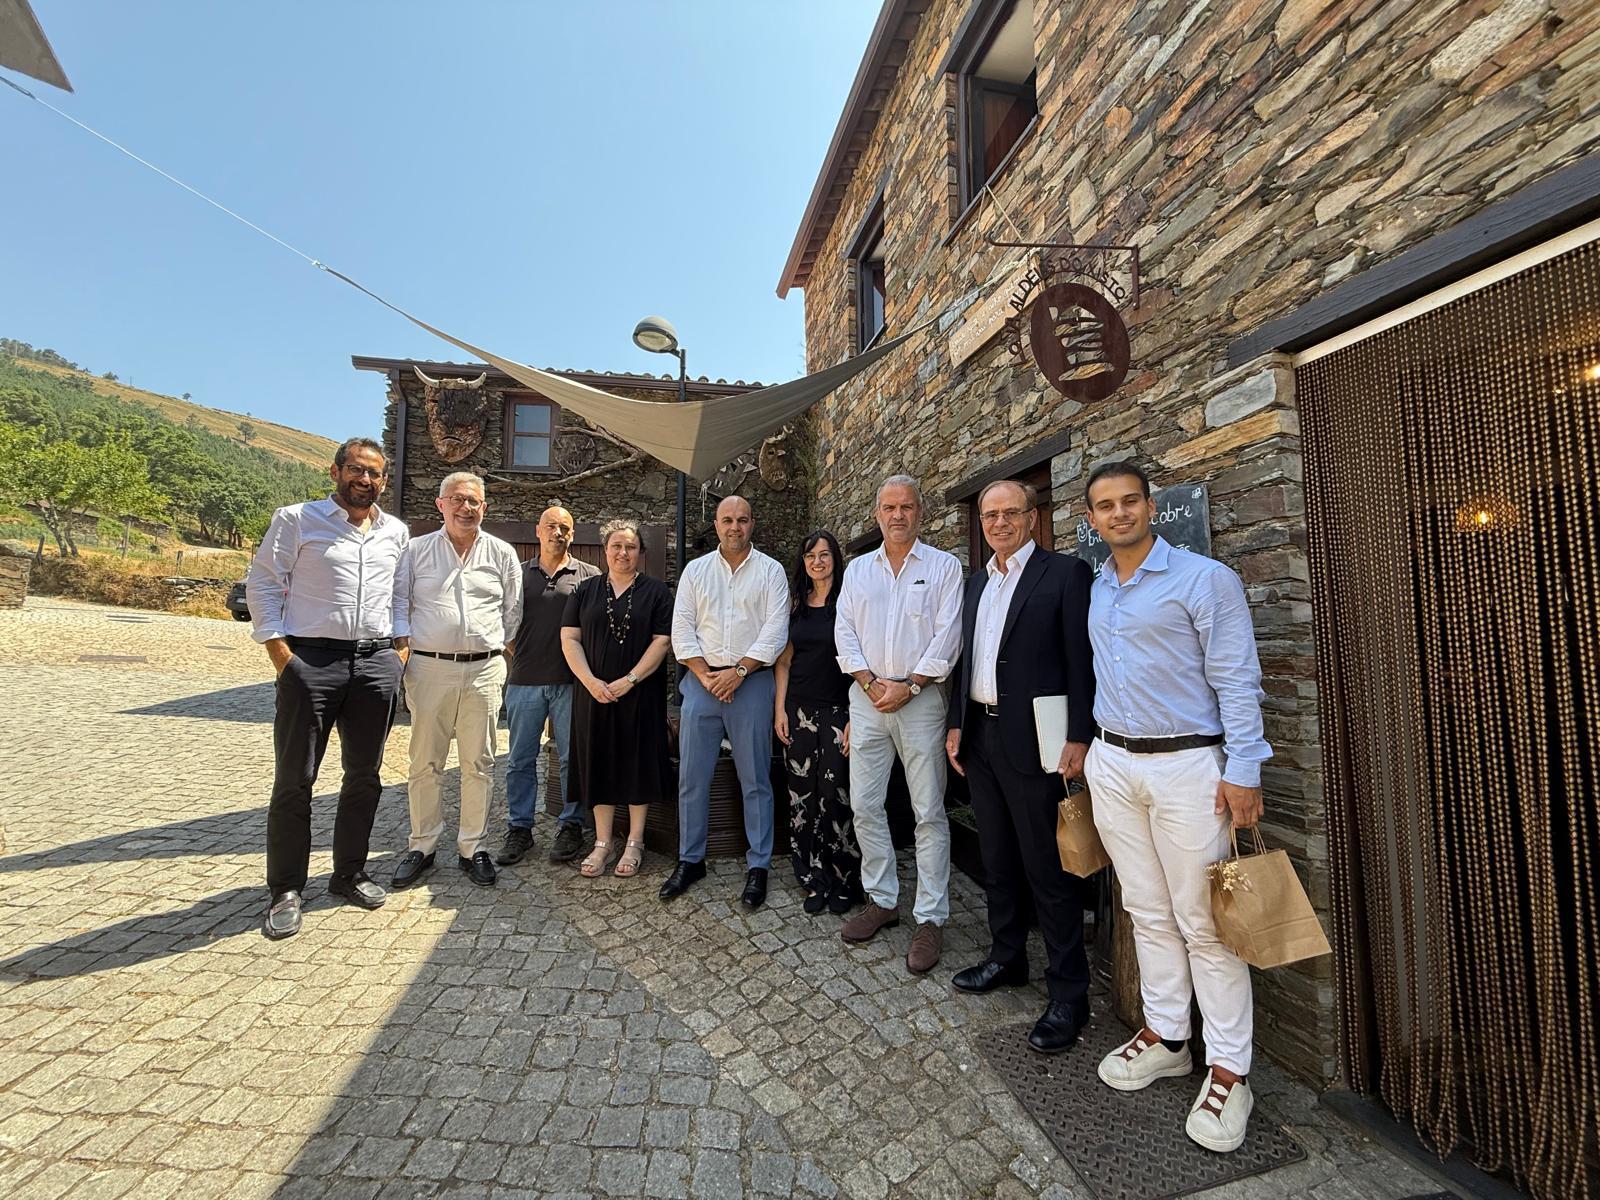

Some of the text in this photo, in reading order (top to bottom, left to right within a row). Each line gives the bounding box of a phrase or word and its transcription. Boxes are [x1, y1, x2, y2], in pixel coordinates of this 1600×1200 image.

[1009, 259, 1055, 312] ALDEIS
[1059, 257, 1082, 271] DO
[1149, 501, 1193, 525] cobre
